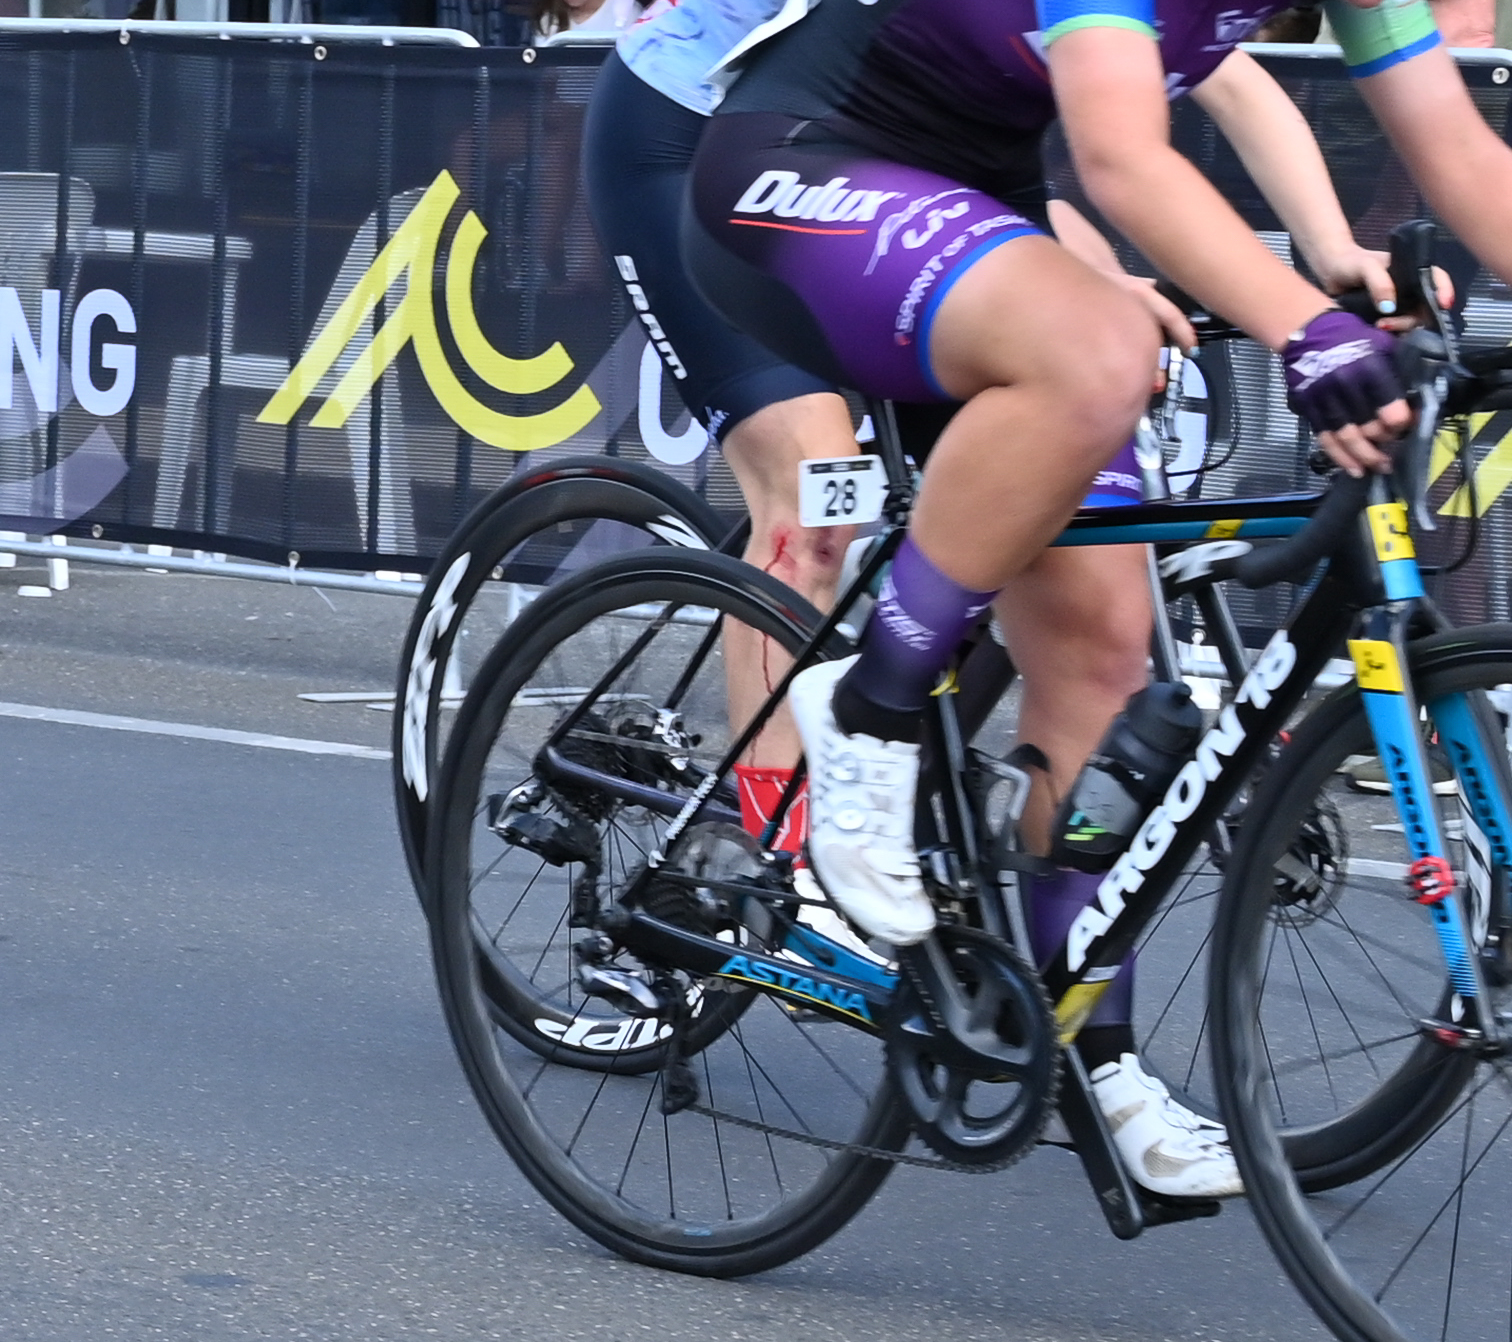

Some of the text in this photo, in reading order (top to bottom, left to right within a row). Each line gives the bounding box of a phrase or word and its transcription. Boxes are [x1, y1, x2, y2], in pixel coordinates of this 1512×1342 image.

[733, 169, 898, 223] Dulux
[823, 478, 857, 517] 28
[1066, 704, 1247, 974] ARGON
[719, 954, 873, 1021] ASTANA
